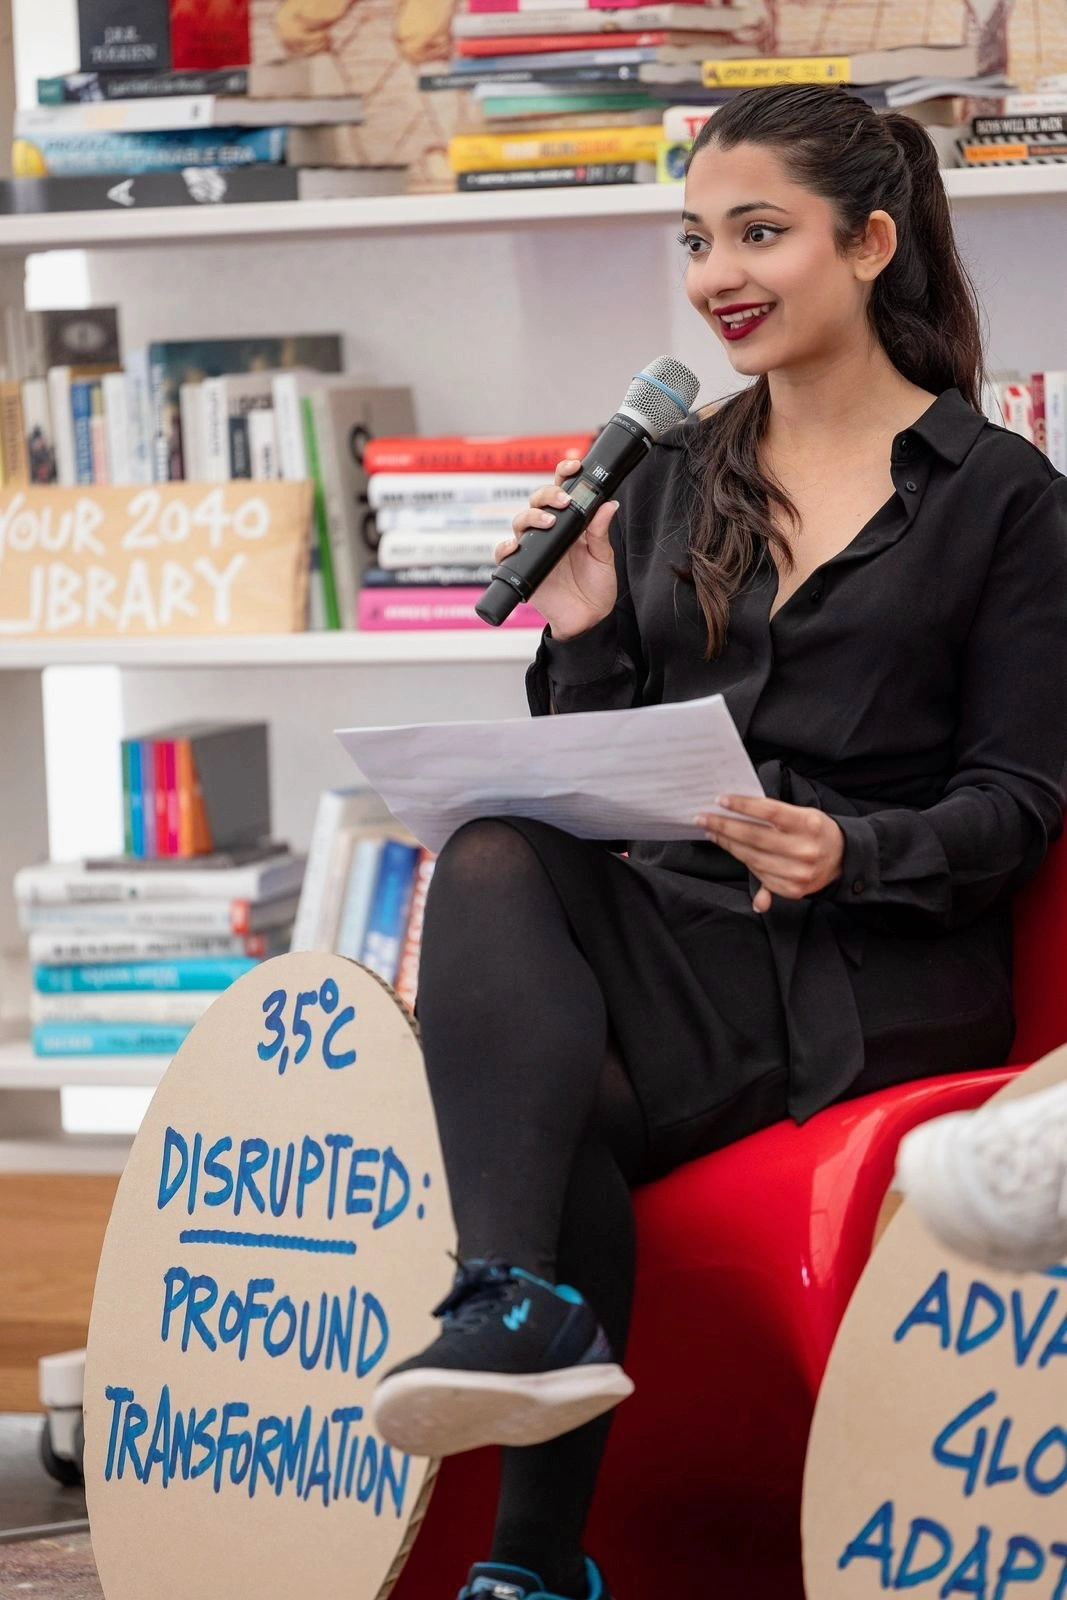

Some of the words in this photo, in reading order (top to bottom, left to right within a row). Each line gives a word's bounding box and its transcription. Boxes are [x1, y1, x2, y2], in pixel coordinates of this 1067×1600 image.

[122, 488, 270, 549] 2040
[592, 465, 609, 482] HH1
[157, 1126, 433, 1230] DISRUPTED:
[161, 1266, 390, 1379] PROFOUND
[104, 1383, 411, 1519] TRANSFORMATION
